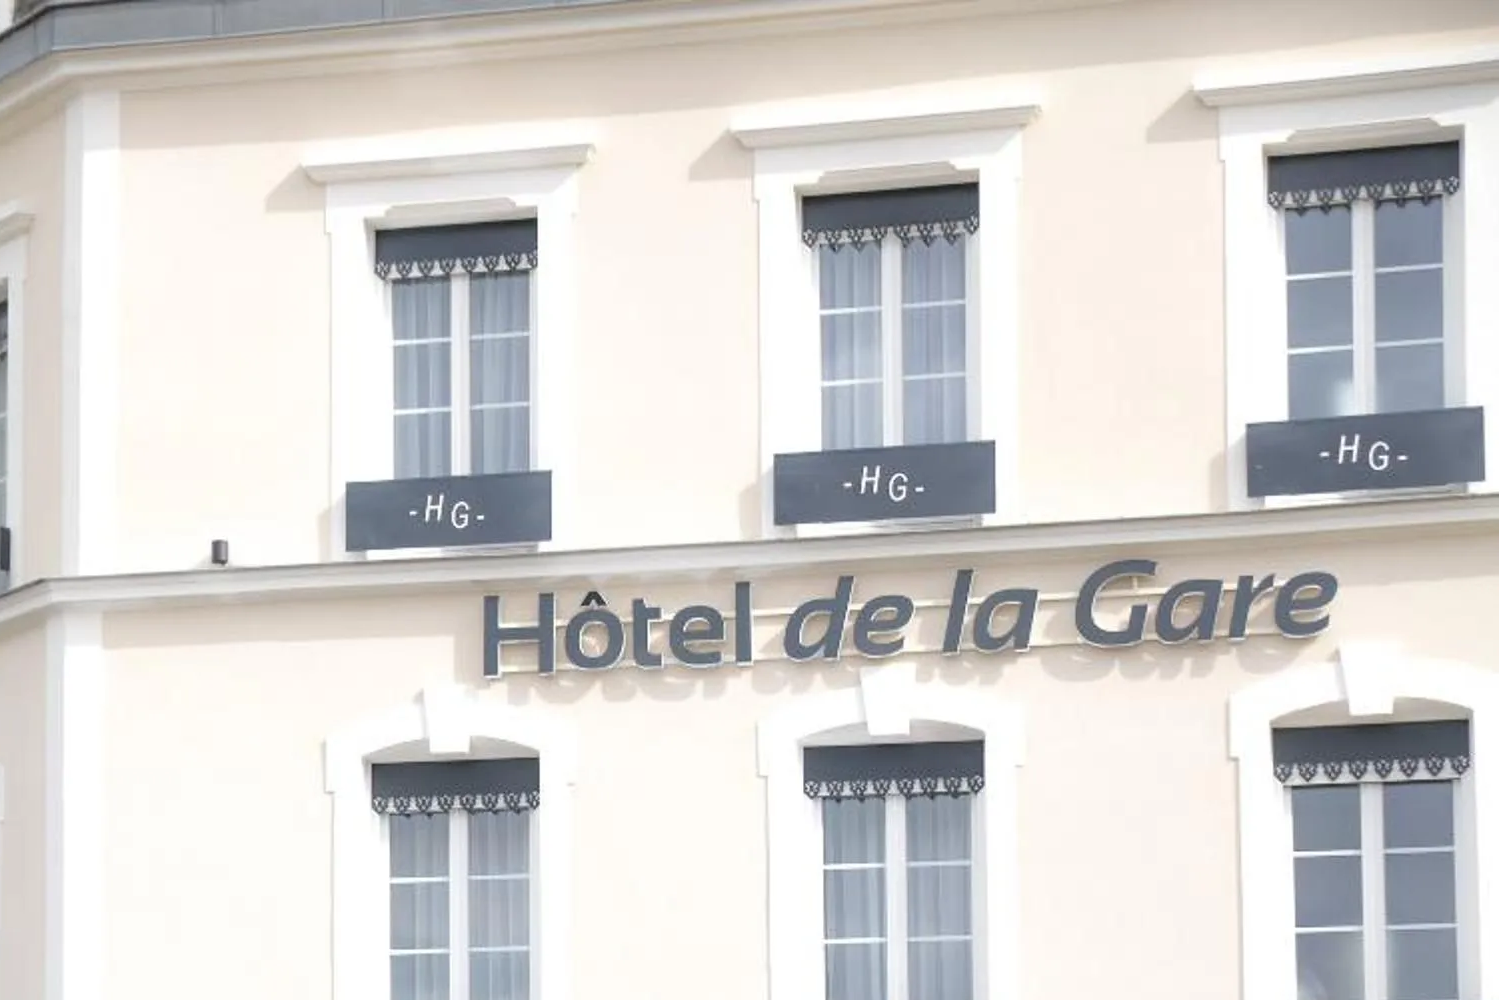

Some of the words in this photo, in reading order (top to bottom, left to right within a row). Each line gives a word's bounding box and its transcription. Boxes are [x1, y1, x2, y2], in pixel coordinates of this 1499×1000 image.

[483, 581, 753, 678] Hôtel
[783, 576, 915, 662] de
[941, 568, 1040, 656] la
[1074, 559, 1339, 648] Gare
